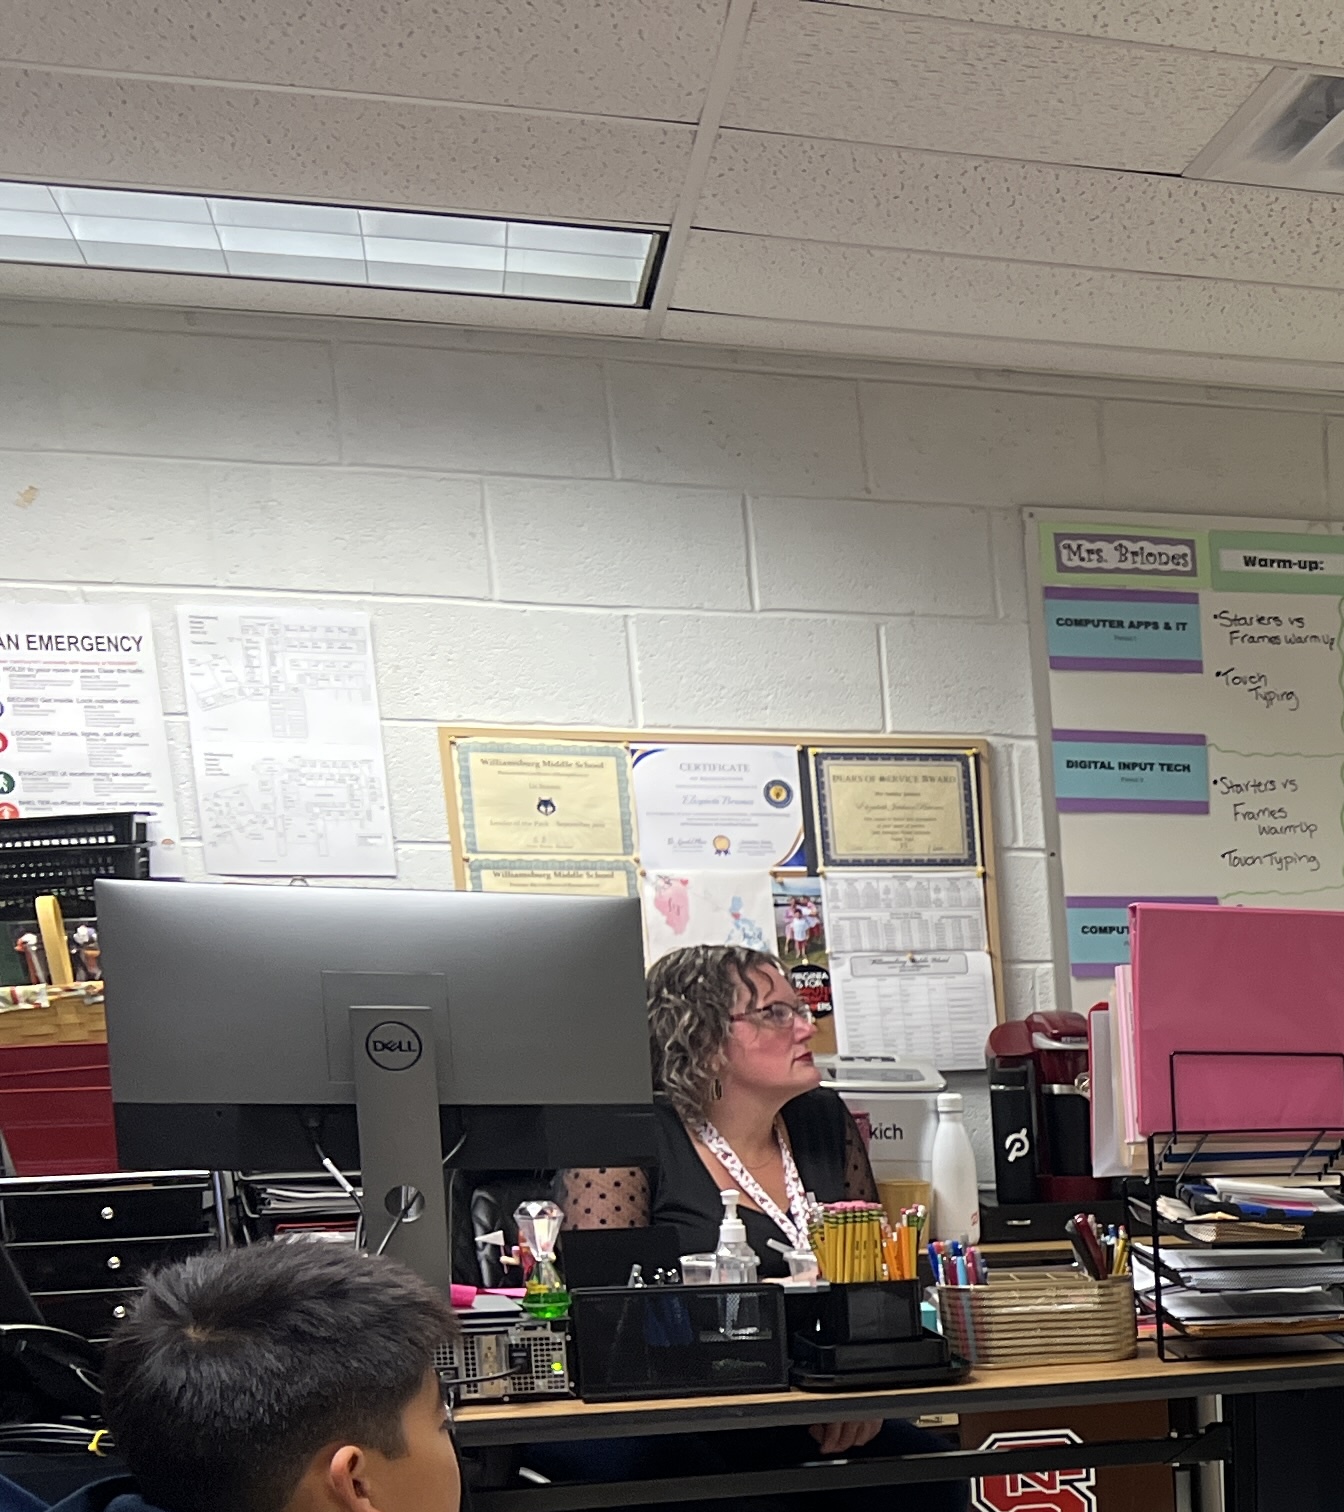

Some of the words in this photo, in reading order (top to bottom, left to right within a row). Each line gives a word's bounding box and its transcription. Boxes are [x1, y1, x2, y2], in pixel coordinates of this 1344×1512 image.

[1063, 543, 1108, 563] Mrs.
[1115, 544, 1189, 567] Briones
[1244, 555, 1324, 571] Warm-up:
[1056, 618, 1125, 629] COMPUTER
[1128, 620, 1159, 630] APPS
[1164, 621, 1172, 630] &
[1177, 622, 1188, 631] IT
[26, 634, 143, 652] EMERGENCY
[680, 763, 750, 772] CERTIFICATE
[1066, 760, 1114, 770] DIGITAL
[1118, 762, 1154, 771] INPUT
[1160, 763, 1190, 772] TECH
[1220, 777, 1276, 795] Starters
[1234, 803, 1287, 821] Frames
[1267, 851, 1320, 871] Typing
[372, 1040, 417, 1052] DELL
